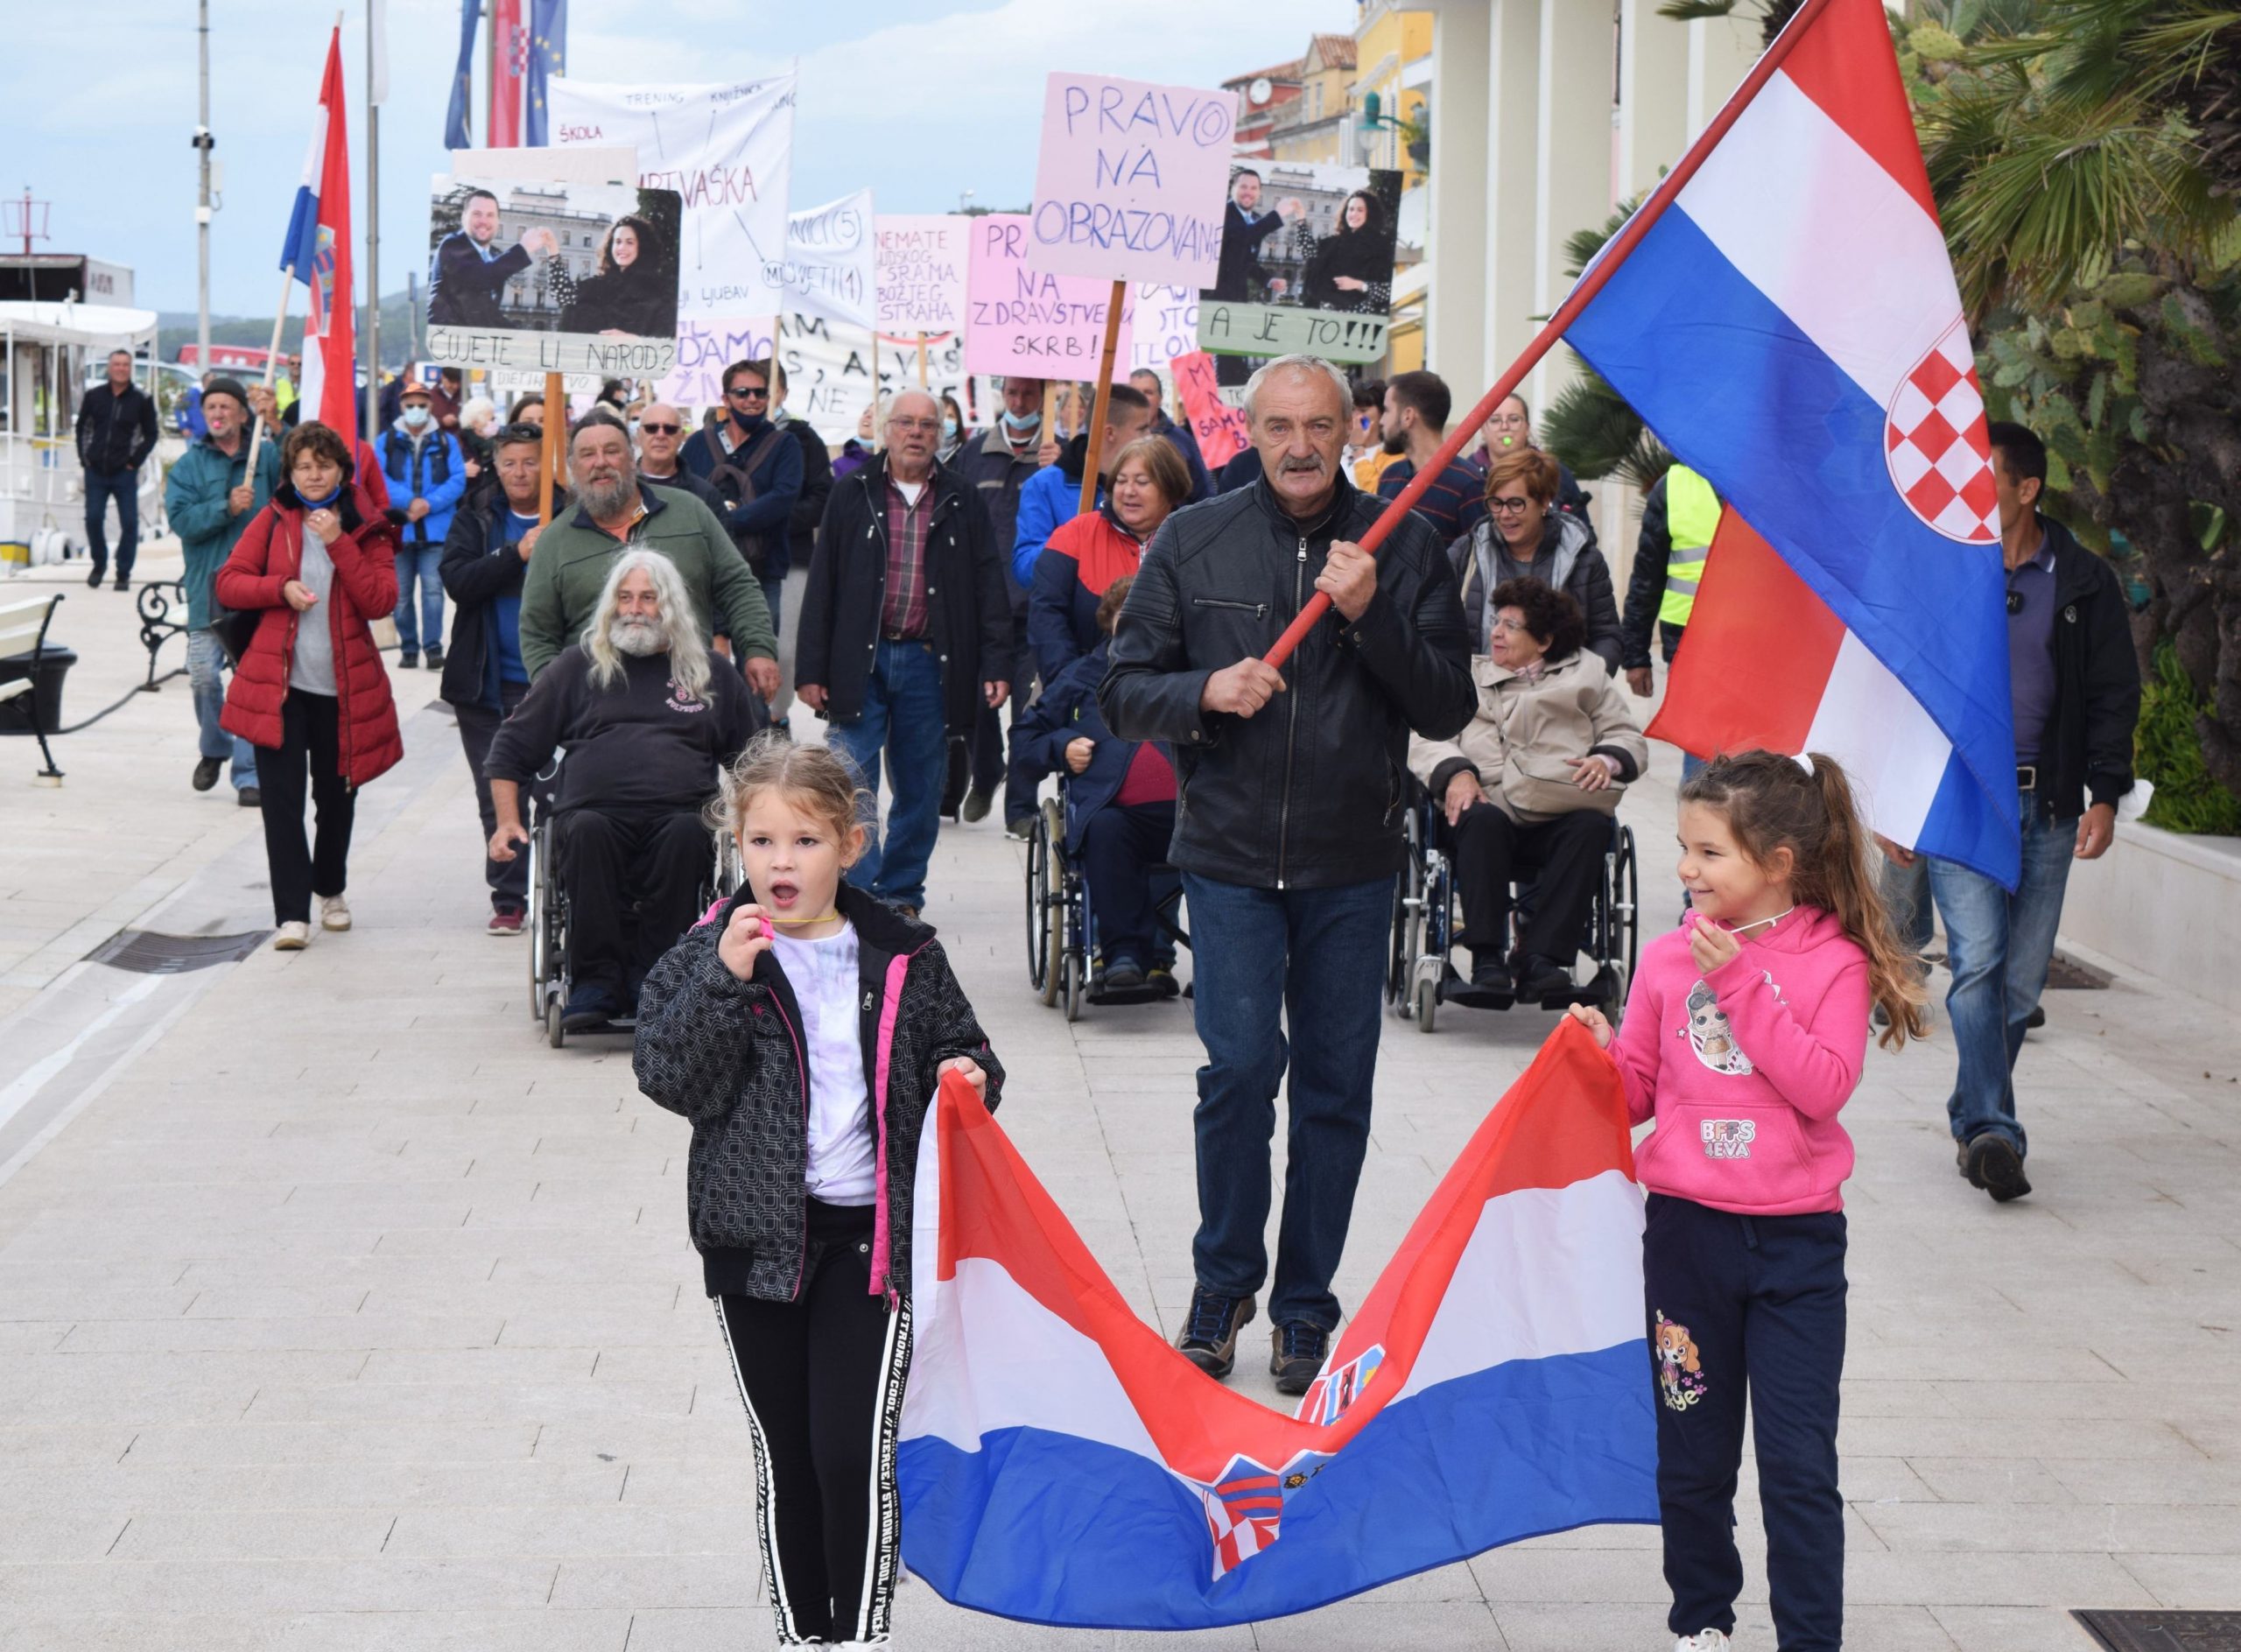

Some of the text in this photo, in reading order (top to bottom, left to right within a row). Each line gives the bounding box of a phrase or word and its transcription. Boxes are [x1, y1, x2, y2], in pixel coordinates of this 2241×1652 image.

[1065, 86, 1230, 147] PRAVO
[559, 124, 603, 143] ŠKOLA
[1096, 148, 1161, 189] NA
[874, 231, 948, 250] NEMATE
[875, 250, 933, 271] JUDSKOG
[887, 263, 959, 283] SRAMA
[1016, 267, 1060, 299] NA
[701, 285, 749, 308] LJUBAV
[879, 302, 955, 322] STRAHA
[973, 299, 1135, 326] ZDRAVSTVEU
[1209, 306, 1384, 351] A JE TO!!!
[429, 327, 675, 372] ČUJETE LI NAROD?
[1700, 1119, 1756, 1143] BFFS
[1704, 1140, 1751, 1159] 4EVA
